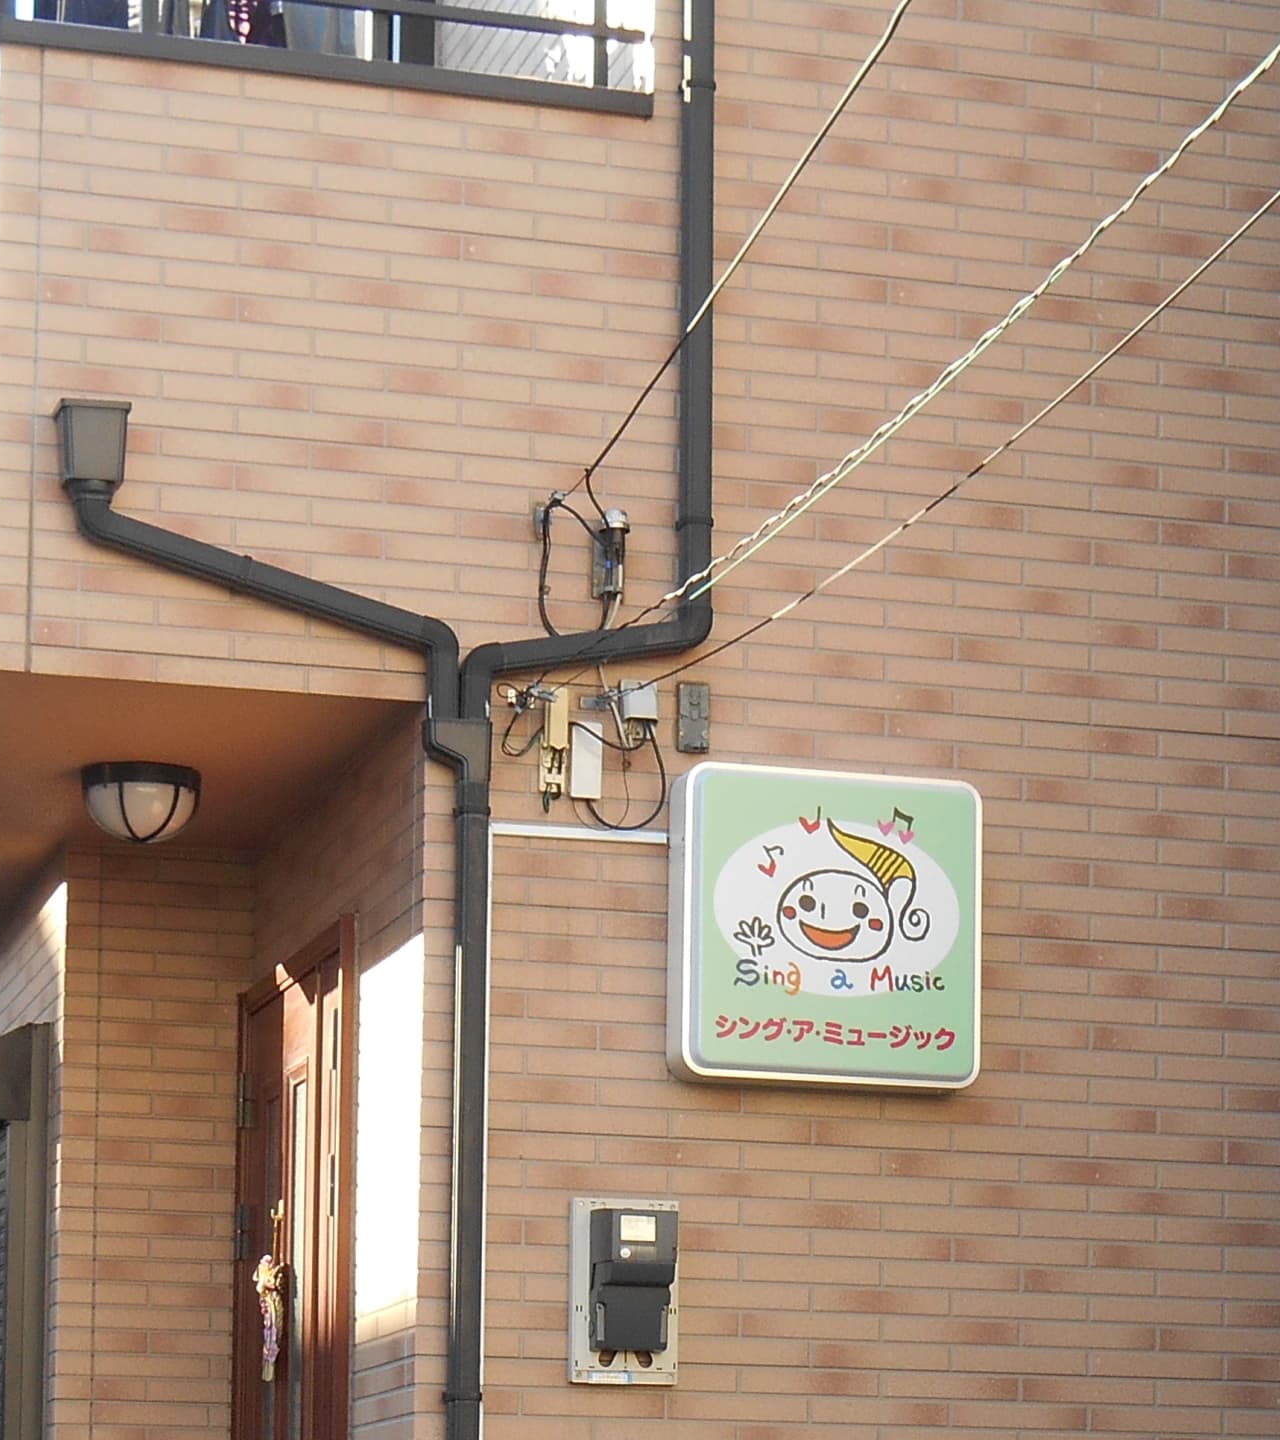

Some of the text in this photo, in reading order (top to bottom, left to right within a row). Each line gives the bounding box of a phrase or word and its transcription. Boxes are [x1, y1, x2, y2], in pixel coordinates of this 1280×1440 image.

[734, 959, 946, 995] Sing a Music
[715, 1015, 956, 1050] シング・ア・ミュージック
